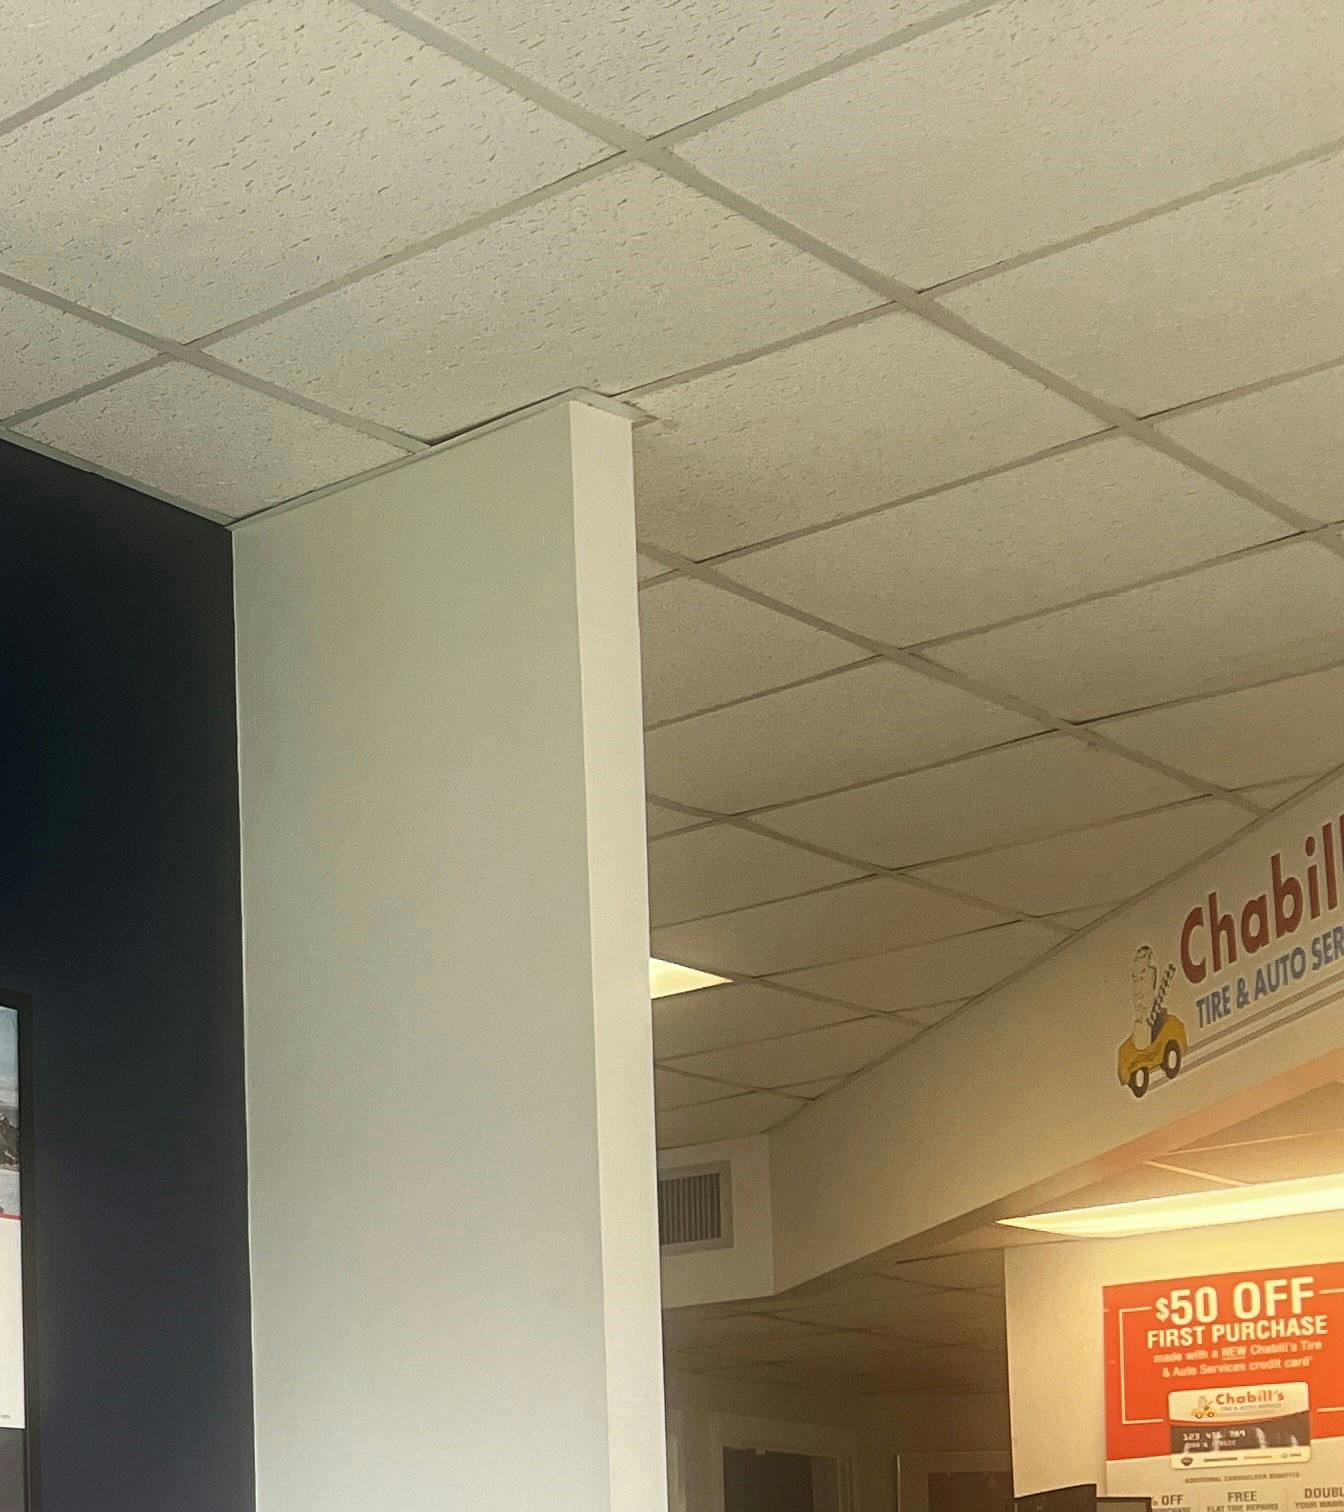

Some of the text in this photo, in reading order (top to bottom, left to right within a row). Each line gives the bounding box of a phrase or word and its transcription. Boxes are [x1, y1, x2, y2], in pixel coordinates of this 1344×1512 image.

[1196, 984, 1231, 1028] TIRE
[1236, 977, 1251, 1009] &
[1254, 946, 1308, 1001] AUTO
[1155, 1277, 1314, 1326] $50 OFF
[1147, 1314, 1328, 1349] FIRST PURCHASE
[1221, 1345, 1247, 1359] NEW
[1300, 1340, 1323, 1351] Tire
[1172, 1365, 1197, 1377] Auto
[1215, 1389, 1285, 1405] Chabill's
[1161, 1494, 1184, 1506] OFF
[1227, 1490, 1257, 1503] FREE
